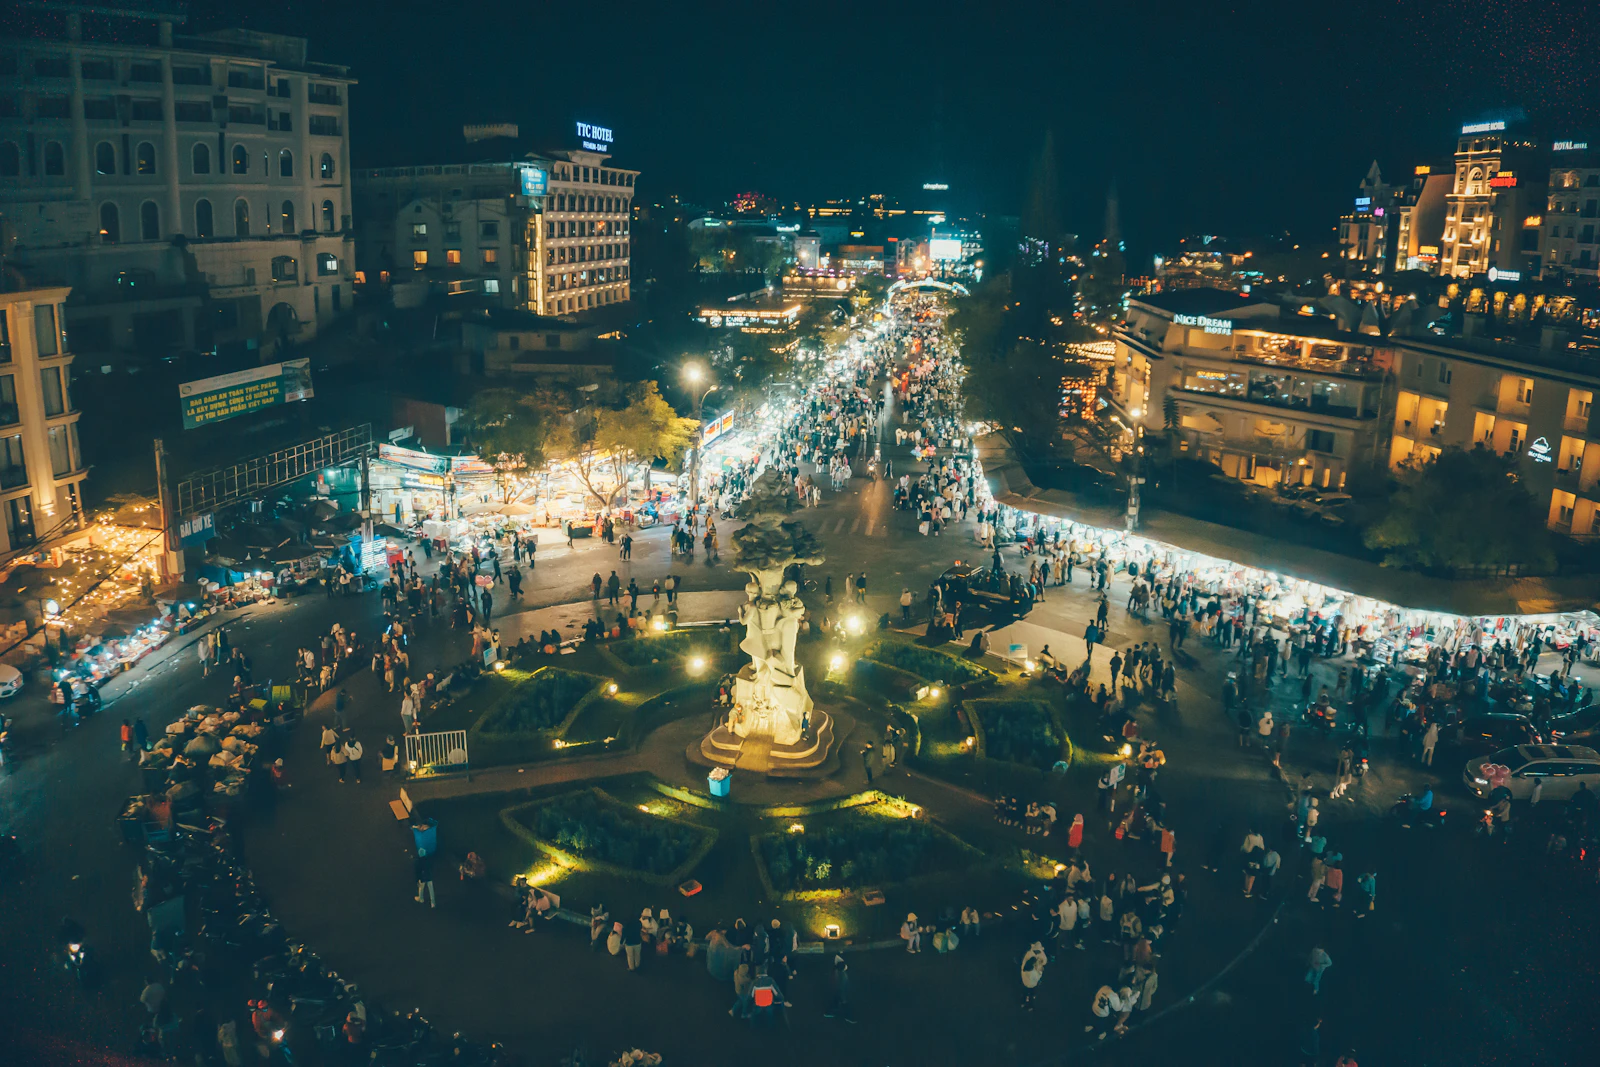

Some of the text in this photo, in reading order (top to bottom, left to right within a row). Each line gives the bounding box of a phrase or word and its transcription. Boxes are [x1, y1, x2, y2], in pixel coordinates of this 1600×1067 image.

[577, 122, 614, 142] TTC HOTEL
[1204, 326, 1232, 335] HOTEL
[203, 514, 212, 530] XE
